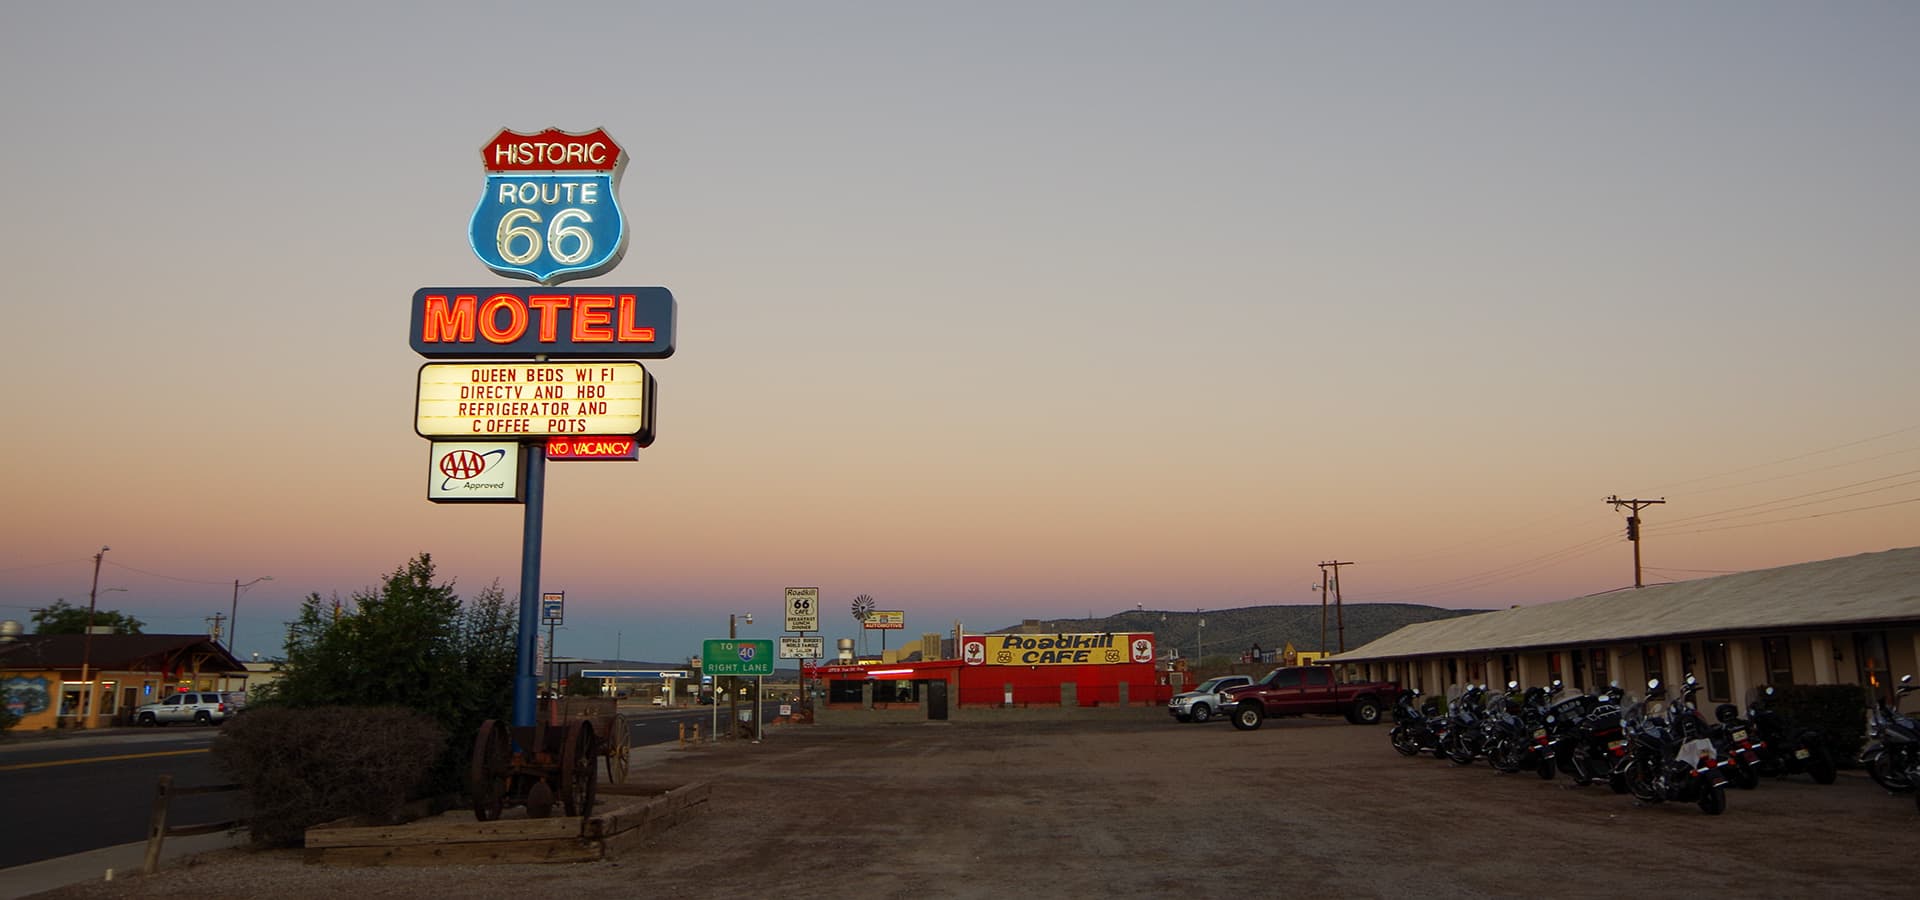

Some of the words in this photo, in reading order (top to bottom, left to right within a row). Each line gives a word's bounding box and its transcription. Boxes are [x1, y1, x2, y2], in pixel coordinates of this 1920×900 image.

[496, 142, 606, 166] HISTORIC
[499, 182, 598, 205] ROUTE
[496, 208, 593, 264] 66
[422, 295, 656, 344] MOTEL
[471, 369, 516, 383] QUEEN
[526, 369, 564, 382] BEDS
[460, 385, 524, 399] DIRECTV
[534, 385, 564, 399] AND
[576, 385, 606, 398] HBO
[458, 402, 569, 416] REFRIGERATOR
[578, 402, 607, 416] AND
[548, 419, 586, 432] POTS
[549, 442, 568, 455] NO
[572, 442, 630, 456] VACANCY
[442, 452, 484, 479] AAA
[464, 481, 504, 490] Approved
[794, 600, 810, 609] 66
[1002, 634, 1115, 649] Roadkill
[740, 648, 753, 658] 40
[1022, 650, 1092, 664] CAFE
[708, 664, 737, 672] RIGHT
[743, 664, 768, 672] LANE
